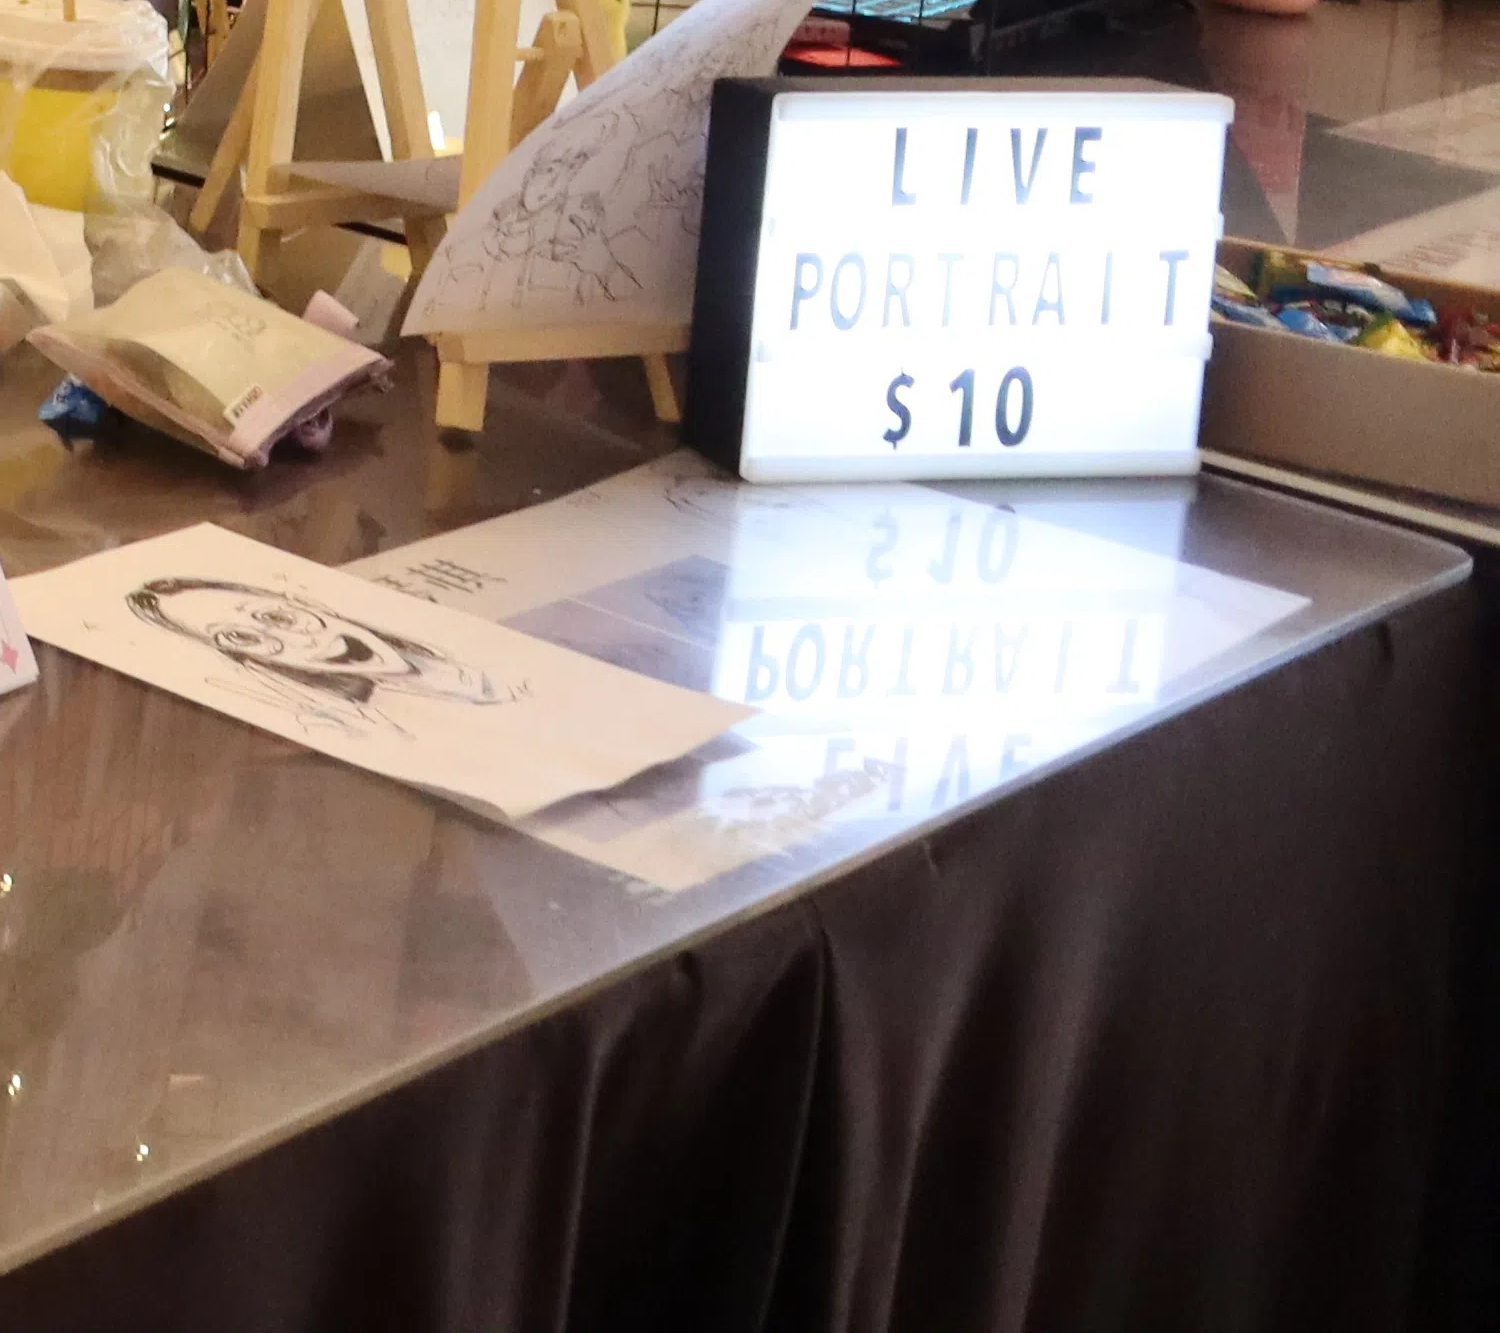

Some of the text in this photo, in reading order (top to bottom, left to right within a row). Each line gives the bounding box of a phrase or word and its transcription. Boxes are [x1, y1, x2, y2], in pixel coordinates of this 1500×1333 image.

[891, 126, 1103, 206] LIVE
[789, 250, 1190, 331] PORTRAIT
[882, 366, 1034, 450] $10
